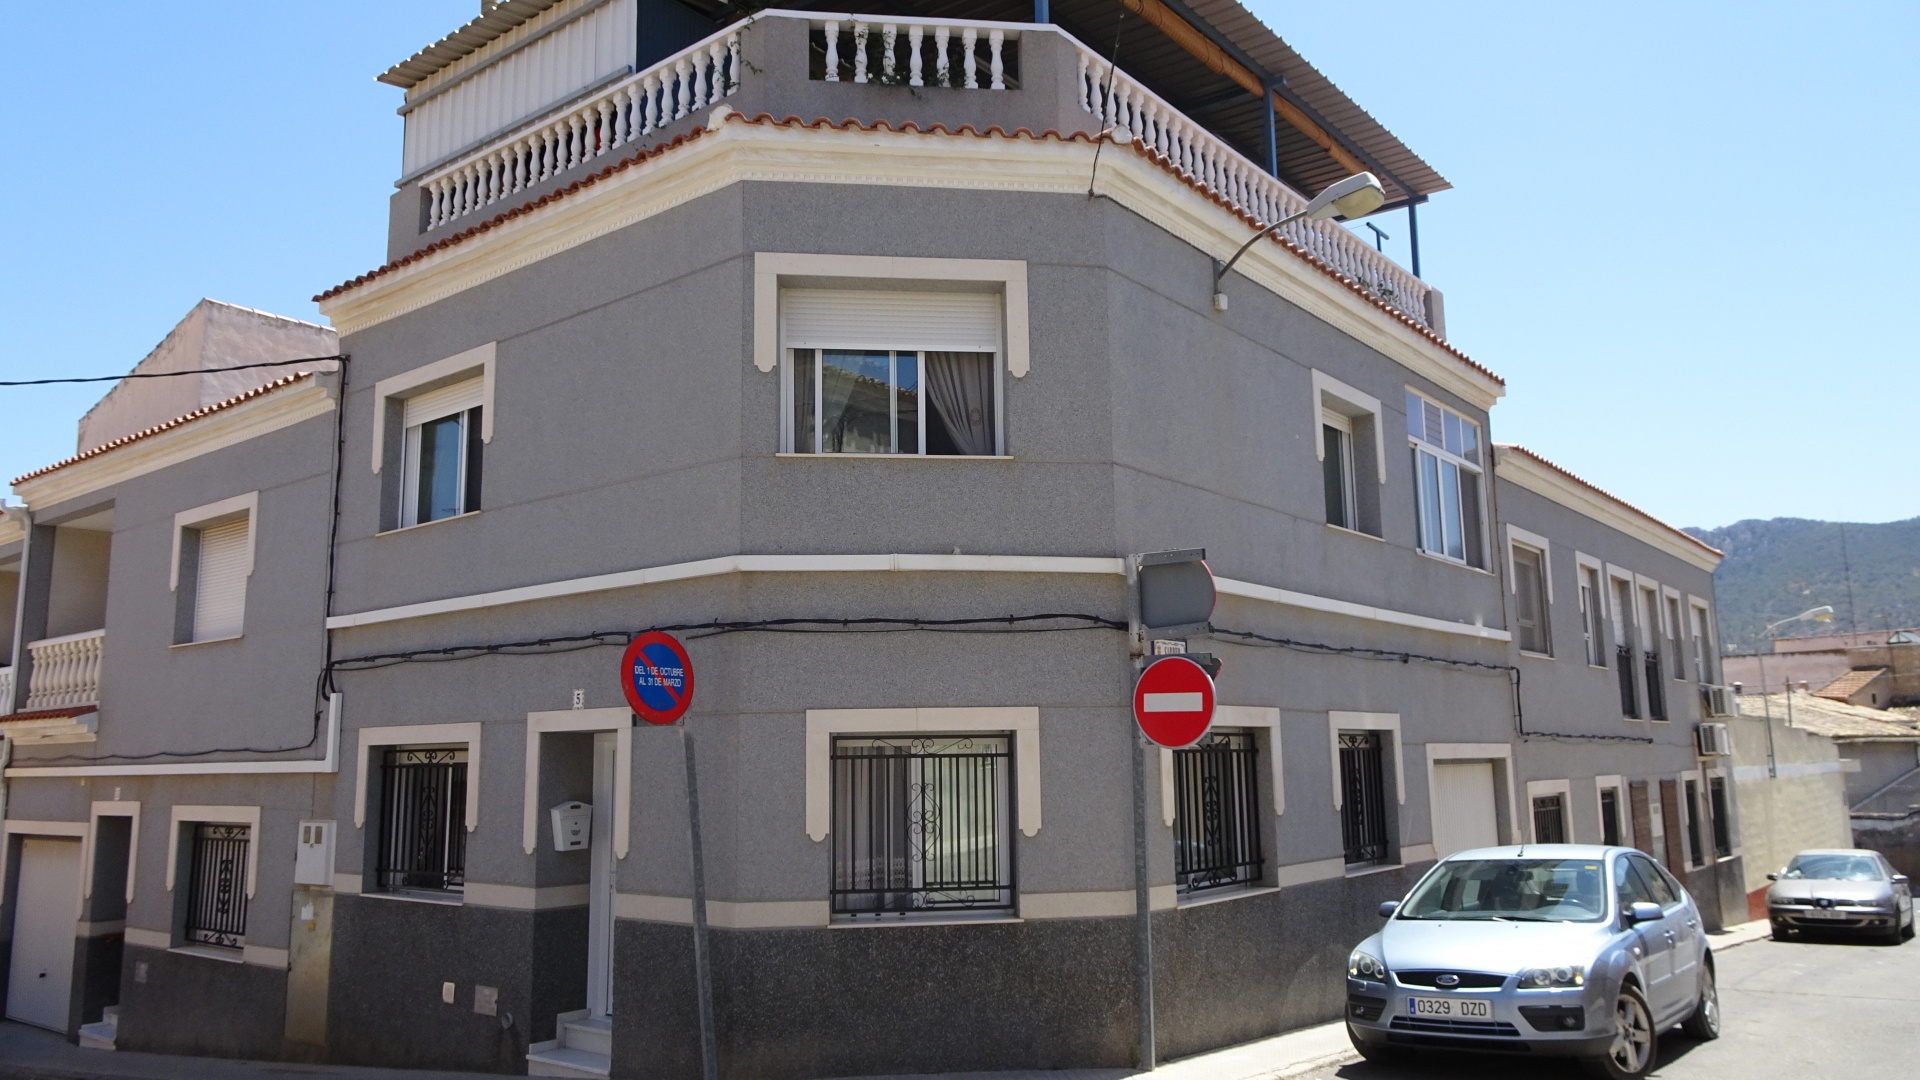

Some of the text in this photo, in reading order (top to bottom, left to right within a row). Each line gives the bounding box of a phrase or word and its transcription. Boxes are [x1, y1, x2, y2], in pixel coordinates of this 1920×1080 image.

[634, 665, 684, 677] DEL 1 DE OCTUBRE
[639, 676, 682, 687] AL 31 DE MARZO
[575, 692, 581, 705] 5
[1417, 999, 1487, 1017] 0329 DZD
